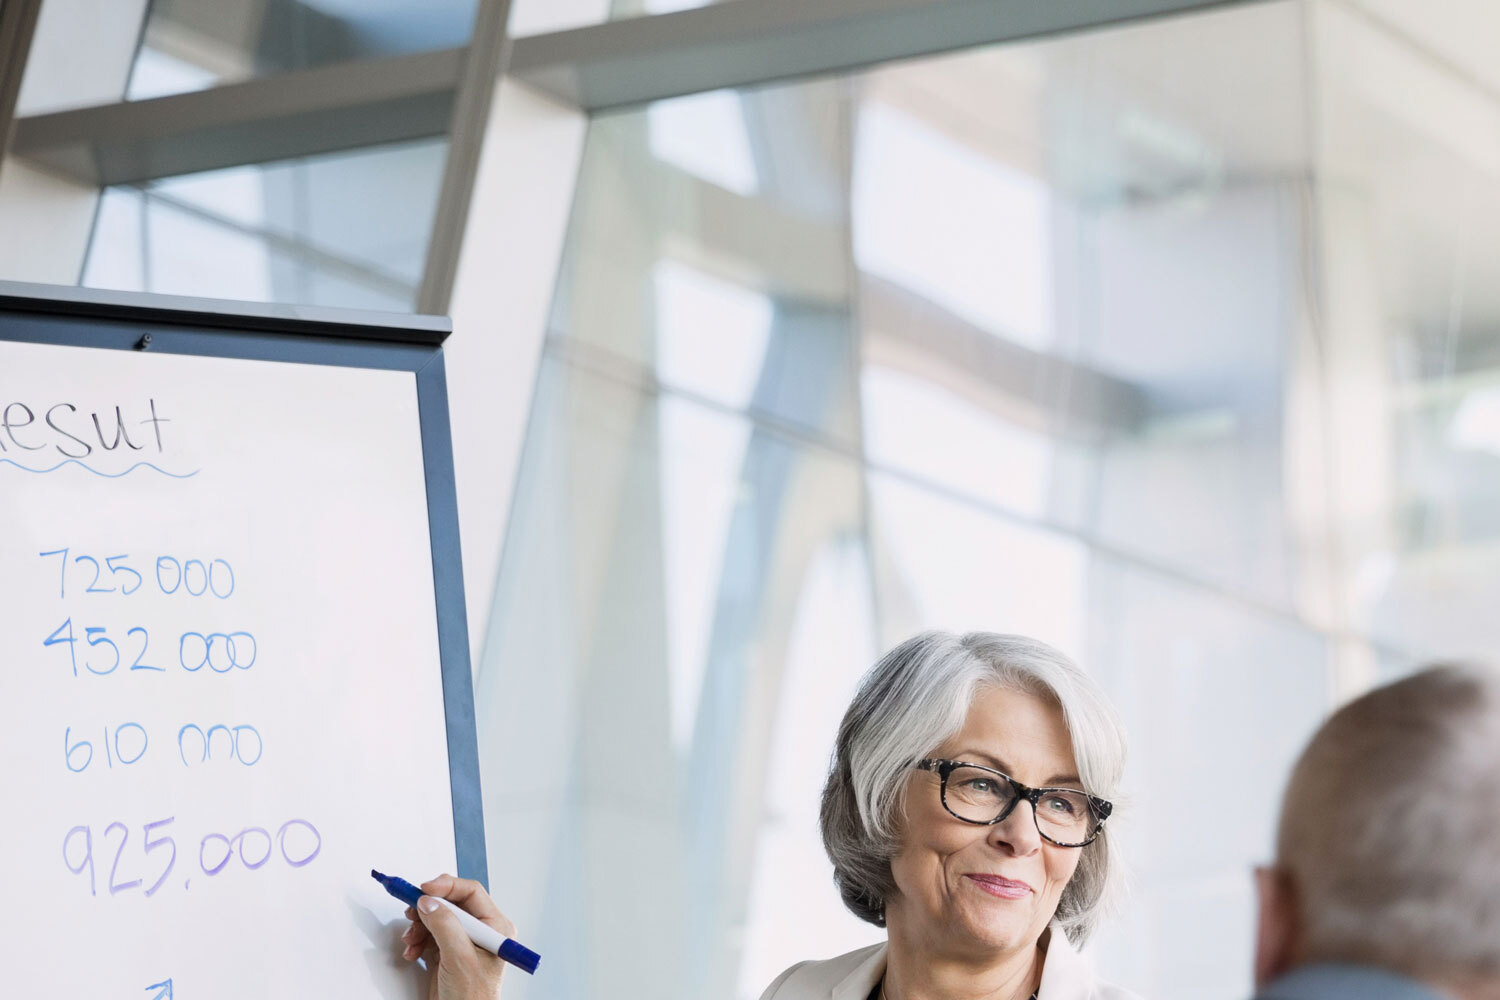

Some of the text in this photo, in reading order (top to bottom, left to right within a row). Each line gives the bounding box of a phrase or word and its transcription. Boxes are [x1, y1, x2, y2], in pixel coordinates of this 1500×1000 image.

[0, 398, 171, 459] esut
[39, 547, 235, 600] 725 000
[43, 617, 257, 677] 452 000
[65, 722, 148, 773] 610
